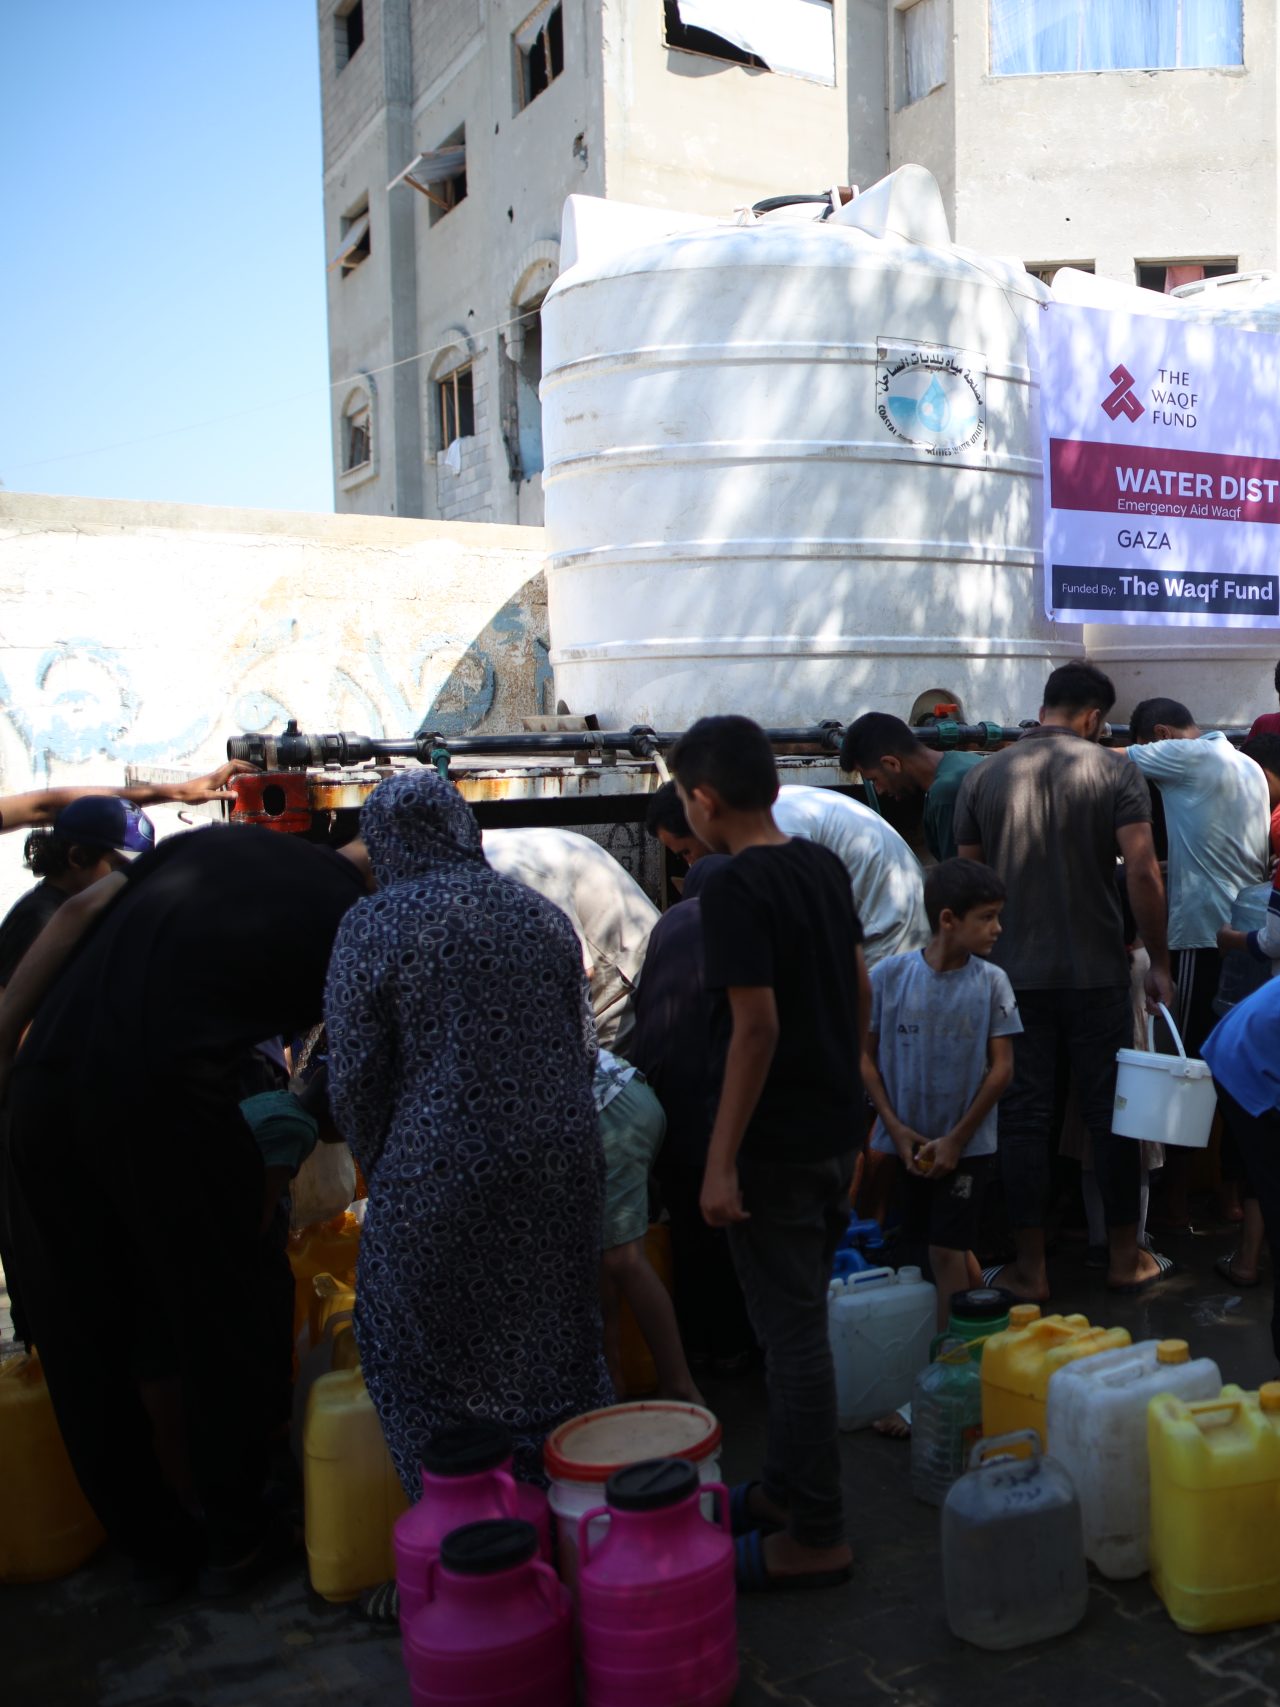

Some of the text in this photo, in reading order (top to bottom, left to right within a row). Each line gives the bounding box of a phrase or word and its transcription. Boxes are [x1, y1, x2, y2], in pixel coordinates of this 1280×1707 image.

[878, 358, 909, 392] الساحل
[1158, 368, 1190, 386] THE
[1151, 389, 1199, 410] WAQF
[878, 404, 897, 435] COASTAL
[972, 418, 985, 445] UTILITY
[1152, 410, 1197, 428] FUND
[1115, 466, 1213, 499] WATER
[1117, 498, 1242, 520] Emergency Aid Waqf
[1117, 529, 1172, 550] GAZA
[1062, 575, 1273, 603] Funded By: The Waqf Fund
